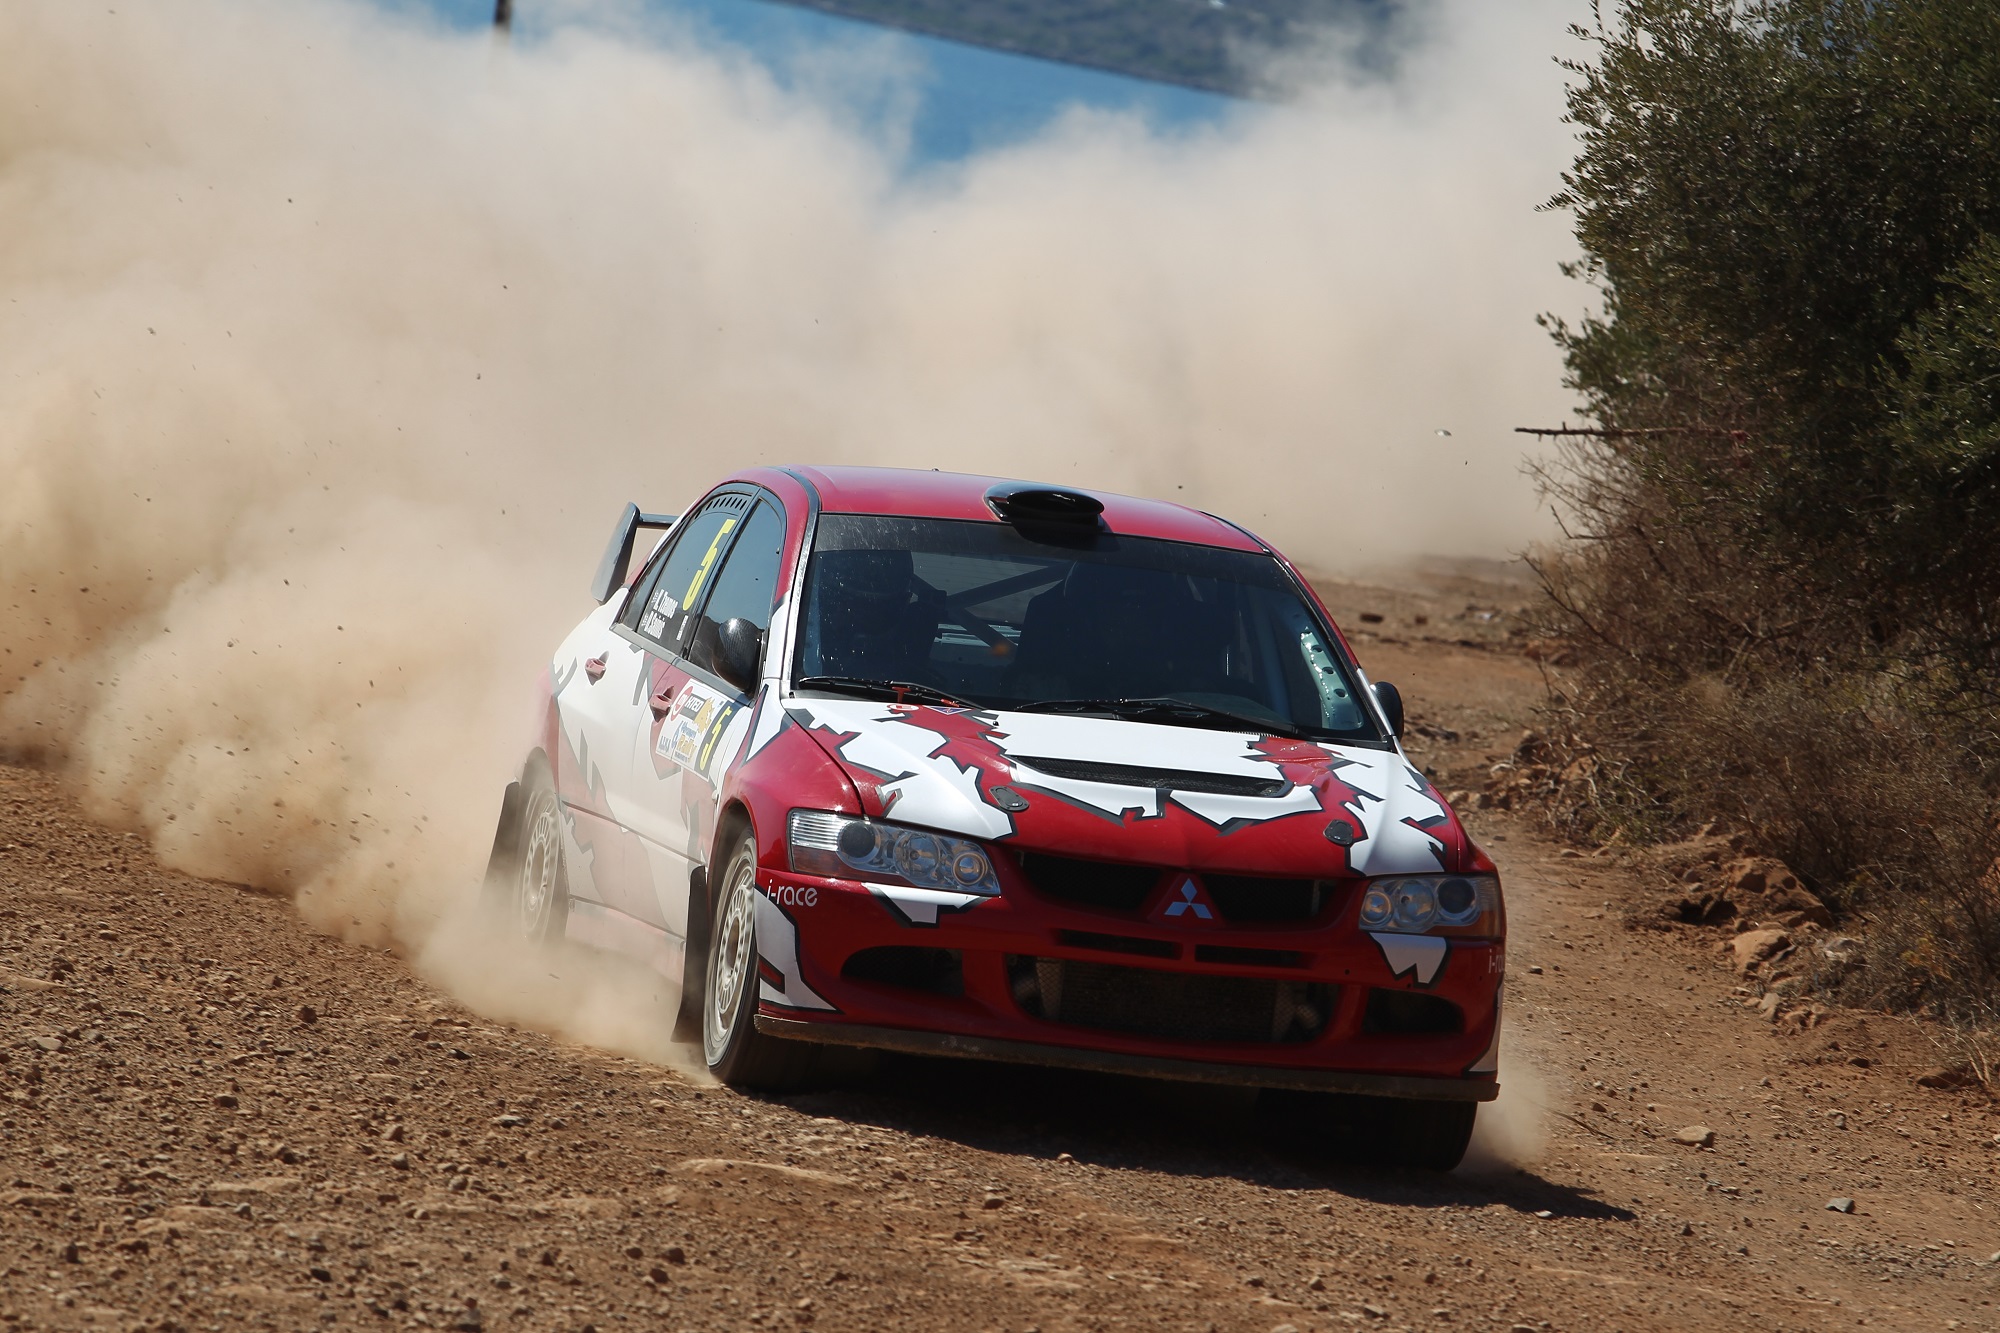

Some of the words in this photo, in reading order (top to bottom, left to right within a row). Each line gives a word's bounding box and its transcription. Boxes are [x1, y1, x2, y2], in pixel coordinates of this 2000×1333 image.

[683, 519, 736, 611] 5
[700, 705, 733, 771] 5
[767, 878, 818, 907] i-race
